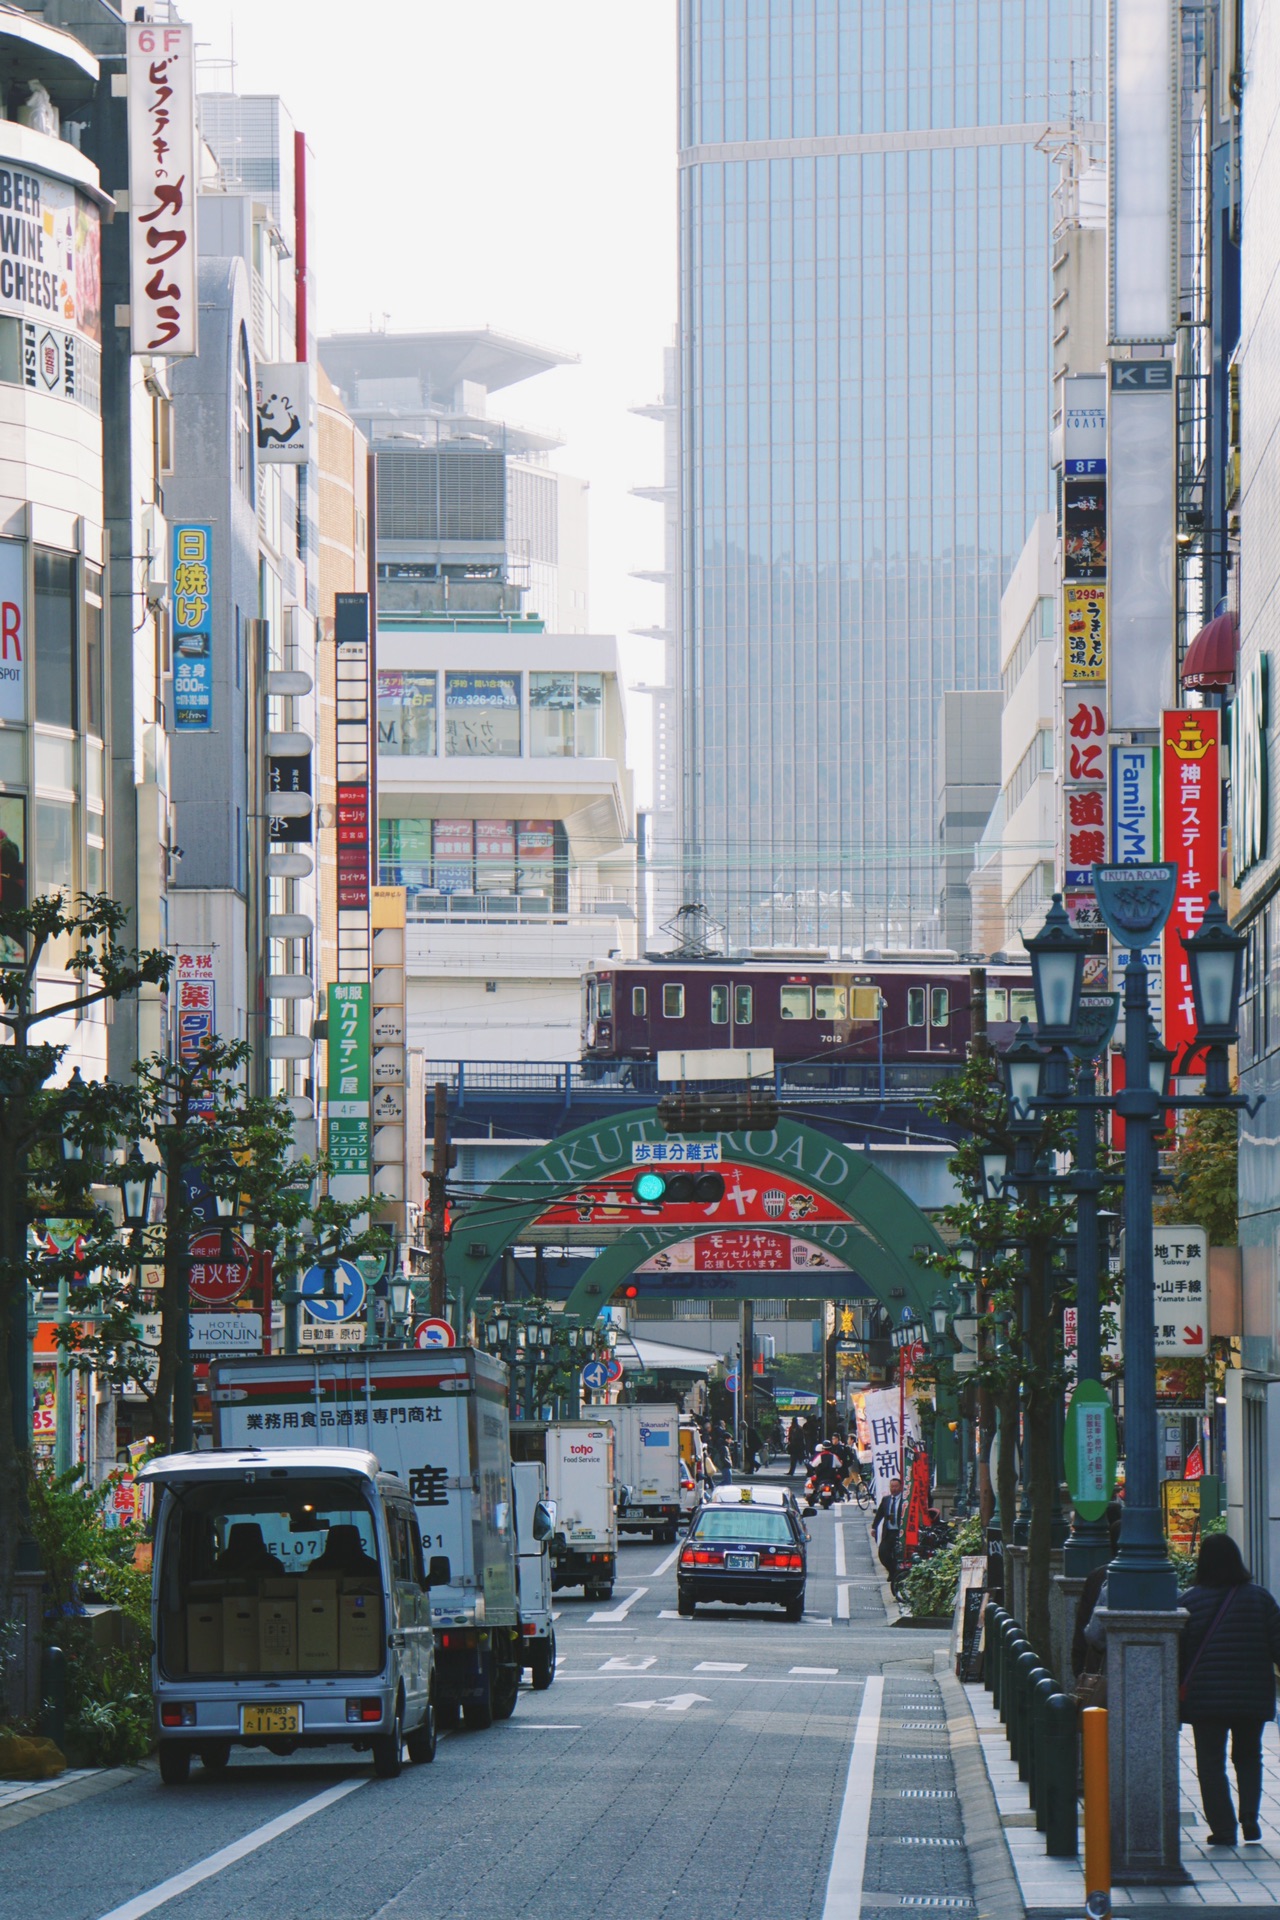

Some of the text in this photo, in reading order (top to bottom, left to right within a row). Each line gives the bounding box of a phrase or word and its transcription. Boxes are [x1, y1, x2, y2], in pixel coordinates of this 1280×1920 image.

[138, 30, 182, 52] 6F
[0, 169, 40, 219] BEER
[0, 214, 43, 263] WINE
[1, 258, 59, 312] CHEESE
[25, 323, 36, 388] FISH
[64, 335, 75, 399] SAKE
[1116, 368, 1168, 384] KE
[1067, 417, 1105, 428] COAST
[1075, 460, 1097, 474] 8F
[174, 529, 208, 628] 日焼け
[1068, 636, 1087, 667] 酒場
[177, 663, 206, 677] 全身
[1069, 703, 1105, 779] かに
[338, 811, 365, 821] モーリヤ
[341, 831, 364, 839] 三宮店
[1104, 870, 1168, 881] IKUTA ROAD
[178, 953, 213, 969] 免税
[177, 969, 213, 978] Tax-Free
[181, 981, 210, 1008] 薬
[334, 983, 363, 1000] 制服
[820, 1035, 842, 1043] 7012
[339, 1002, 359, 1095] カクテン屋
[340, 1105, 356, 1114] 4F
[330, 1134, 367, 1144] シューズ
[330, 1148, 367, 1156] エプロン
[635, 1143, 719, 1161] 歩車分離式
[701, 1250, 783, 1259] ヴィッセル神戸を
[1154, 1243, 1202, 1259] 地下鉄
[704, 1260, 782, 1269] 応援しています。
[1162, 1259, 1191, 1267] Subway
[191, 1264, 241, 1284] 消火栓
[199, 1330, 258, 1341] HONJIN
[303, 1328, 361, 1340] 自動車・原付
[246, 1405, 443, 1431] 業務用食品酒類専門商社
[570, 1444, 593, 1455] toho
[257, 1716, 297, 1731] 11-33
